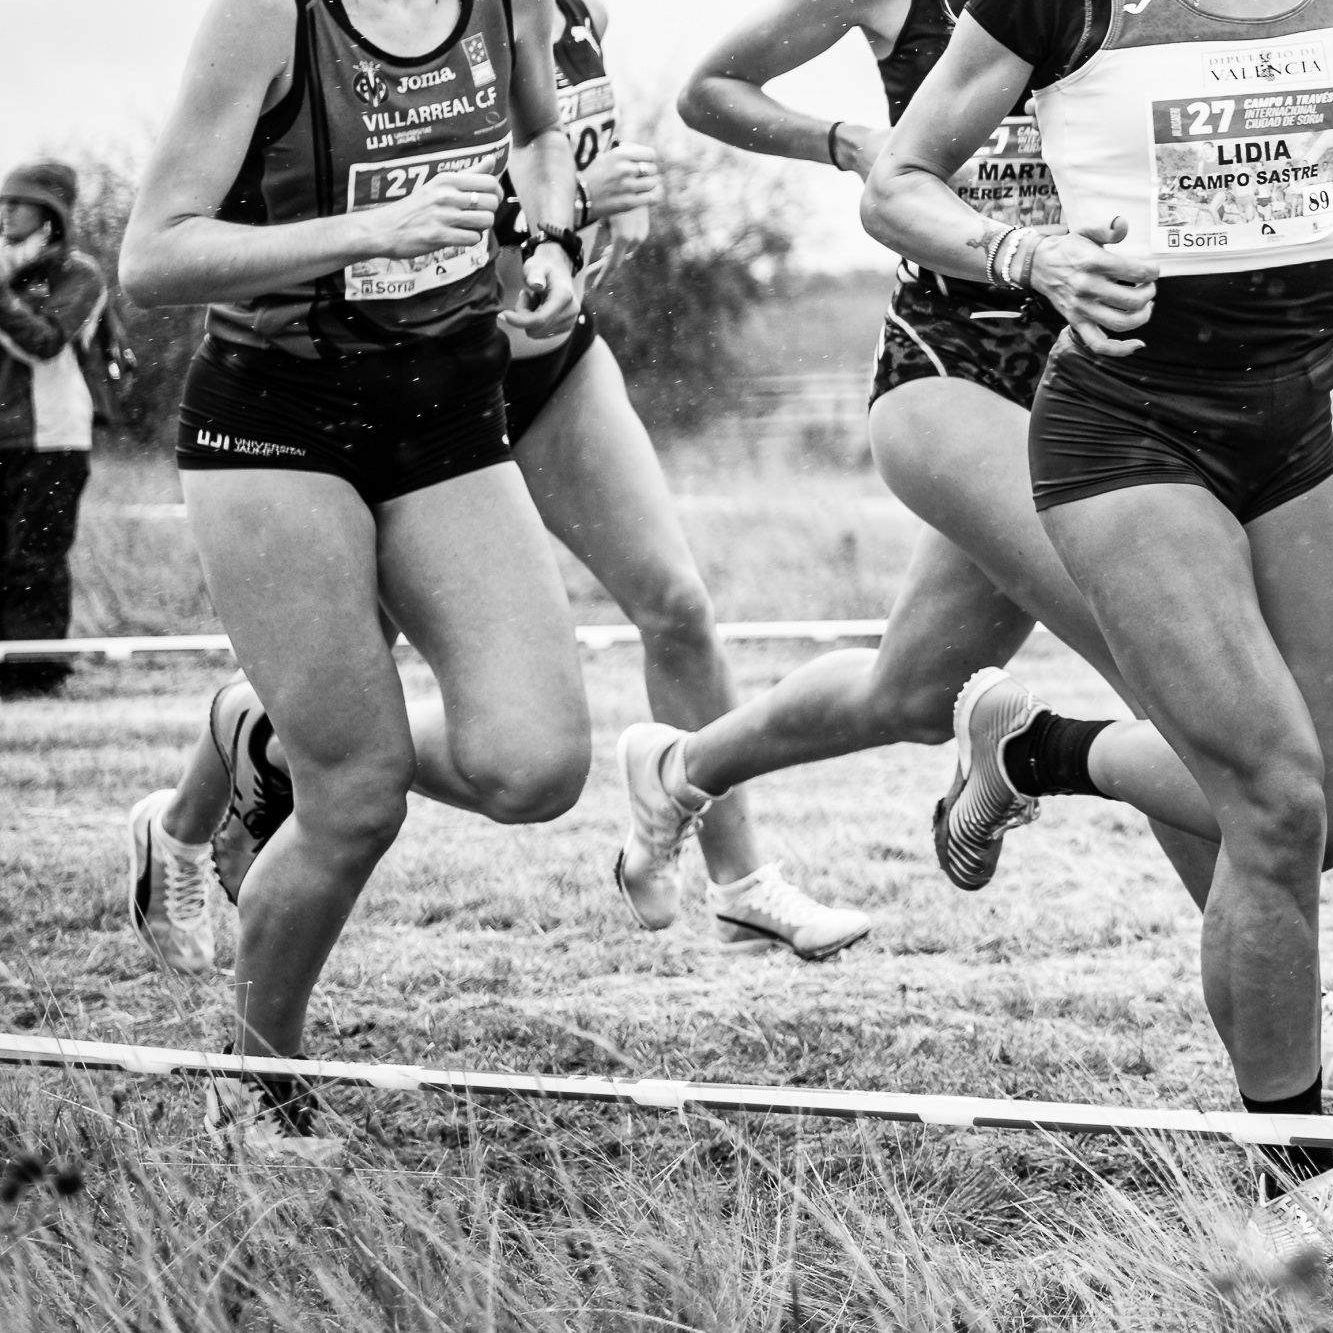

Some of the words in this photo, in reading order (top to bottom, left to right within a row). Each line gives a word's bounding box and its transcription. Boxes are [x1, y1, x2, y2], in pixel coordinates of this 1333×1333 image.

[397, 66, 456, 94] Joma
[1243, 96, 1284, 109] CAMPO
[1284, 95, 1293, 106] A
[1244, 104, 1318, 119] INTERNACIONAL
[362, 96, 475, 132] VILLARREAL
[1186, 99, 1236, 136] 27
[1245, 116, 1280, 129] CIUDAD
[1282, 116, 1296, 126] DE
[1296, 113, 1325, 125] SORIA
[366, 134, 394, 150] UJI
[566, 120, 616, 172] 07
[1217, 140, 1292, 166] LIDIA
[385, 164, 430, 198] 27
[1179, 173, 1250, 190] CAMPO
[1256, 164, 1319, 185] SASTRE
[958, 186, 1014, 200] PEREZ
[1308, 190, 1330, 212] 89
[1183, 233, 1229, 248] Soria
[376, 280, 416, 294] Soria
[197, 428, 230, 451] UJI
